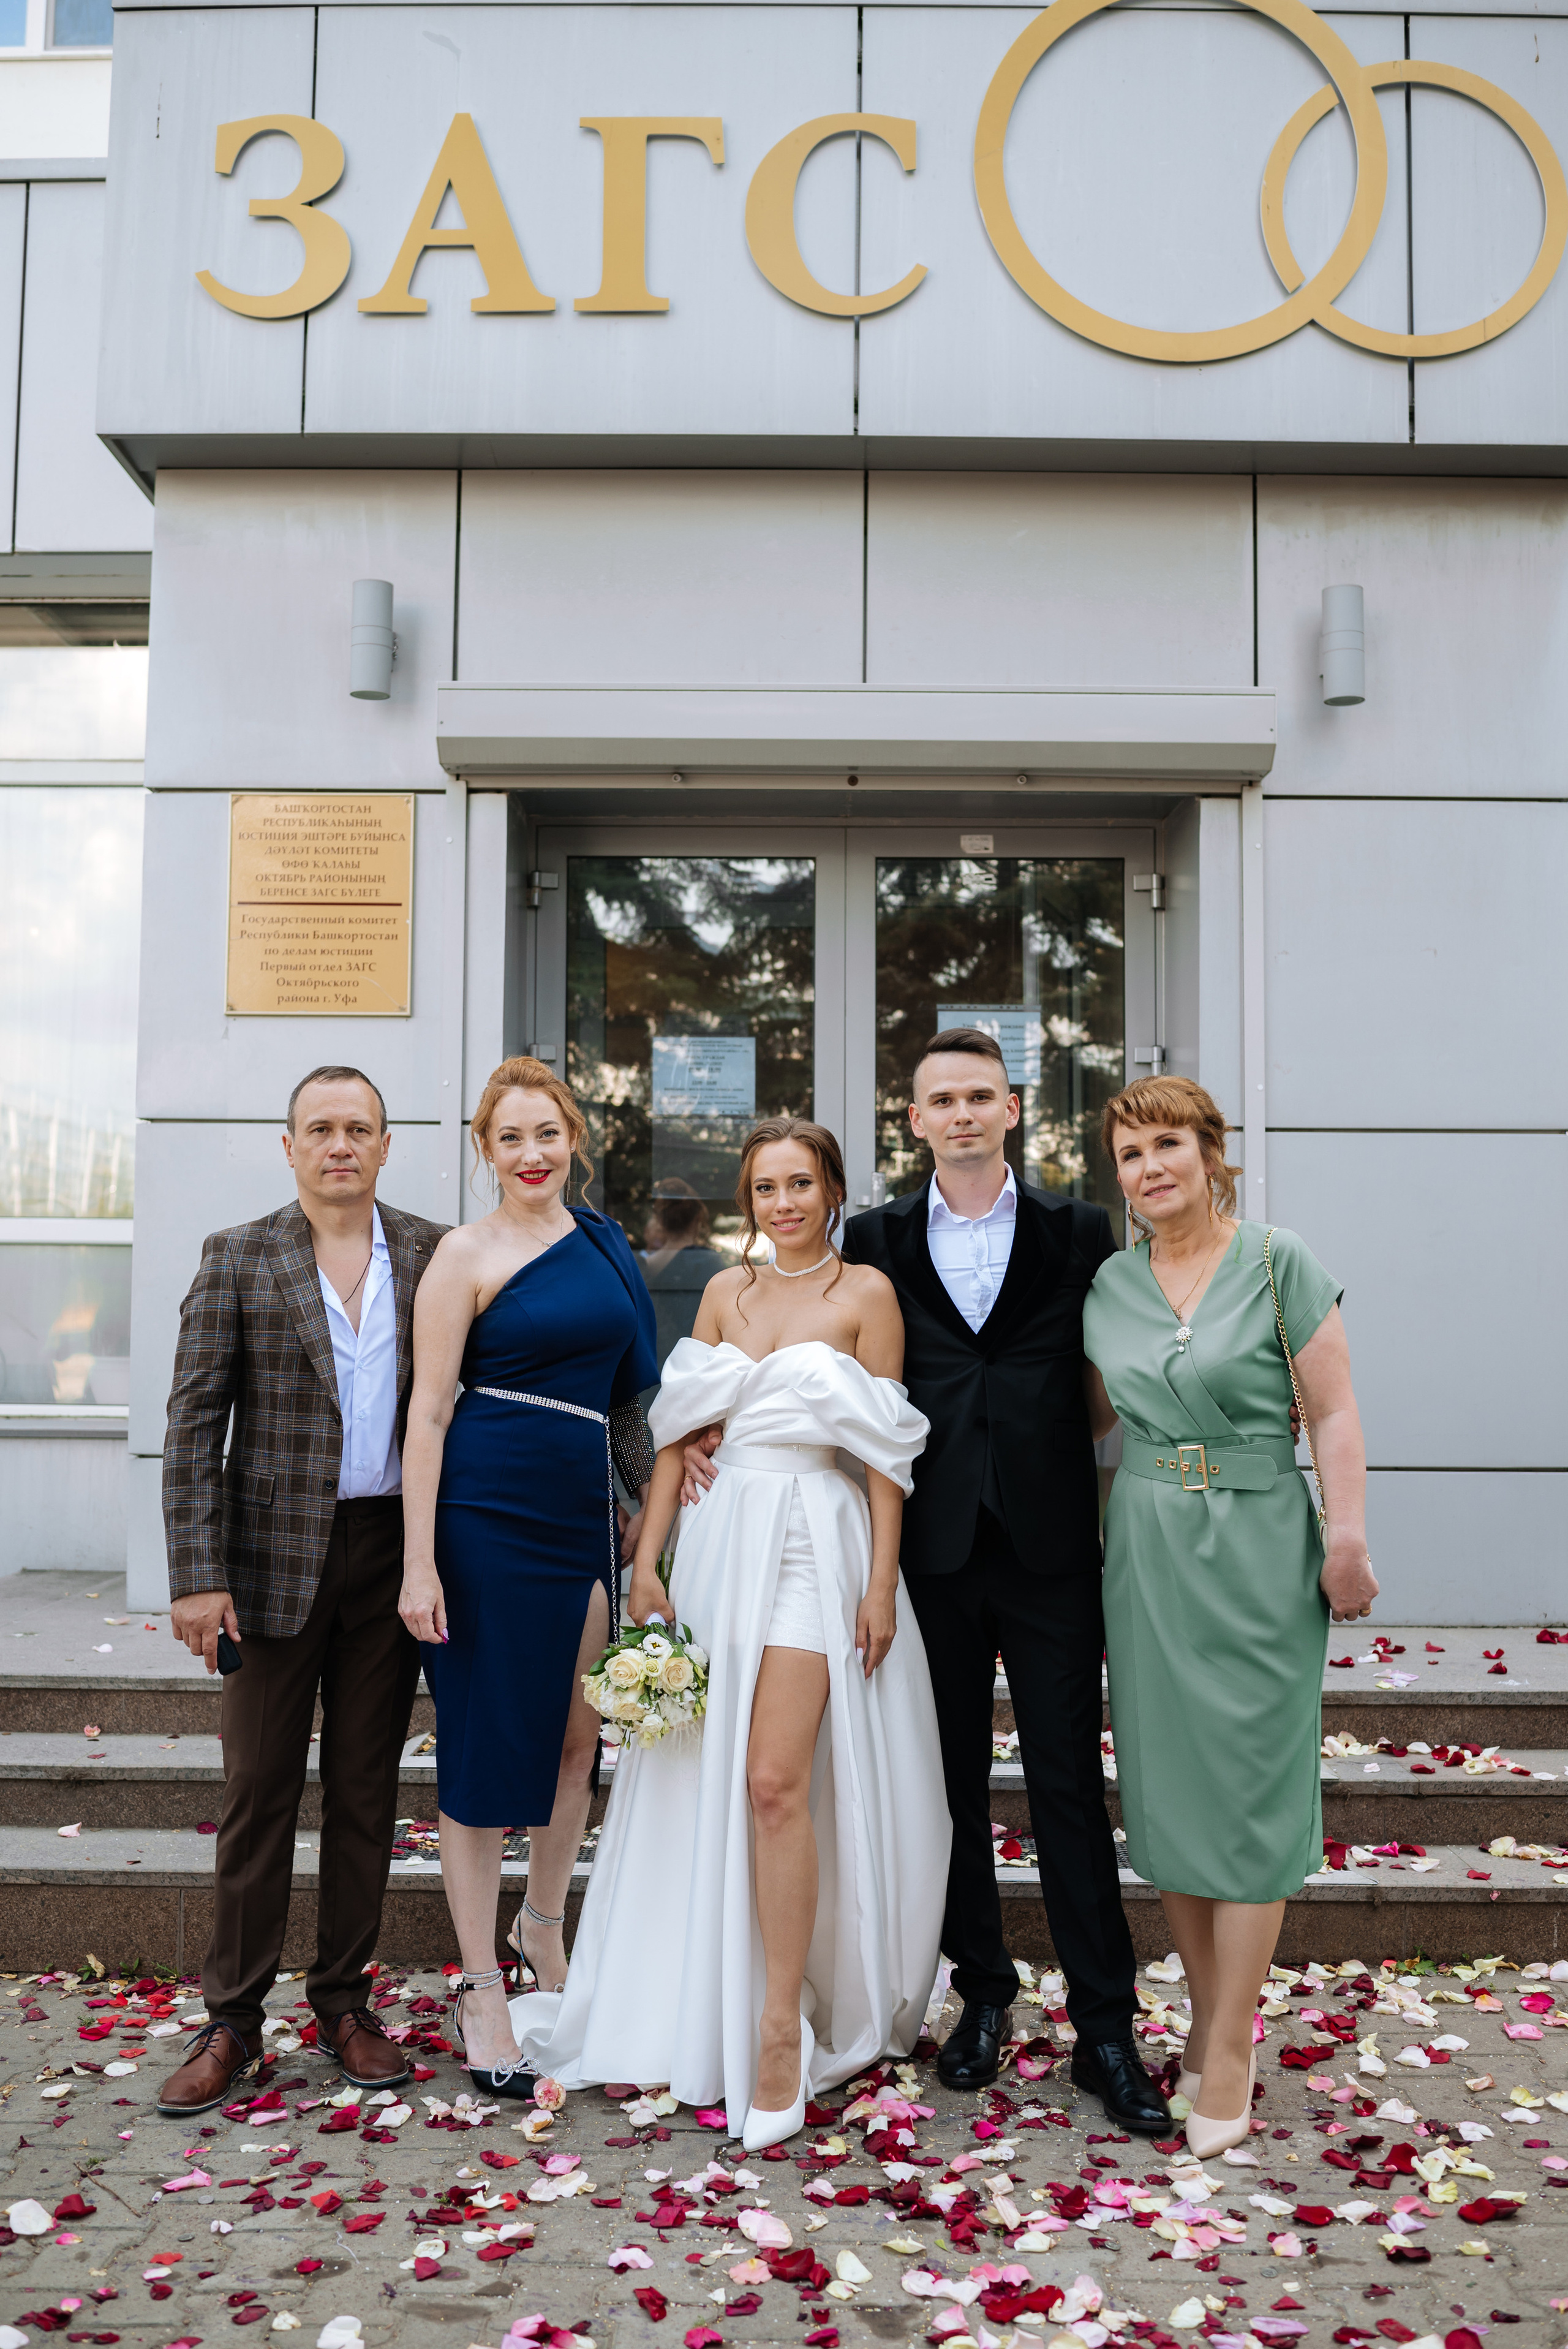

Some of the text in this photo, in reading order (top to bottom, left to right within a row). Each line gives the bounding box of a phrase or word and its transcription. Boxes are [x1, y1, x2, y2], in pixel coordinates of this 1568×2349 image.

[195, 112, 929, 319] ЗАГС
[255, 874, 306, 882] ОКТЯБРЬ
[242, 914, 344, 926] Государственный
[240, 930, 398, 942] Республики Башкортостан
[282, 948, 316, 956] делам
[320, 948, 372, 957] юстиции
[260, 962, 377, 973] Первый отдел ЗАГС
[276, 978, 359, 989] Октябрьского
[277, 994, 319, 1005] района
[334, 994, 356, 1005] Уфа
